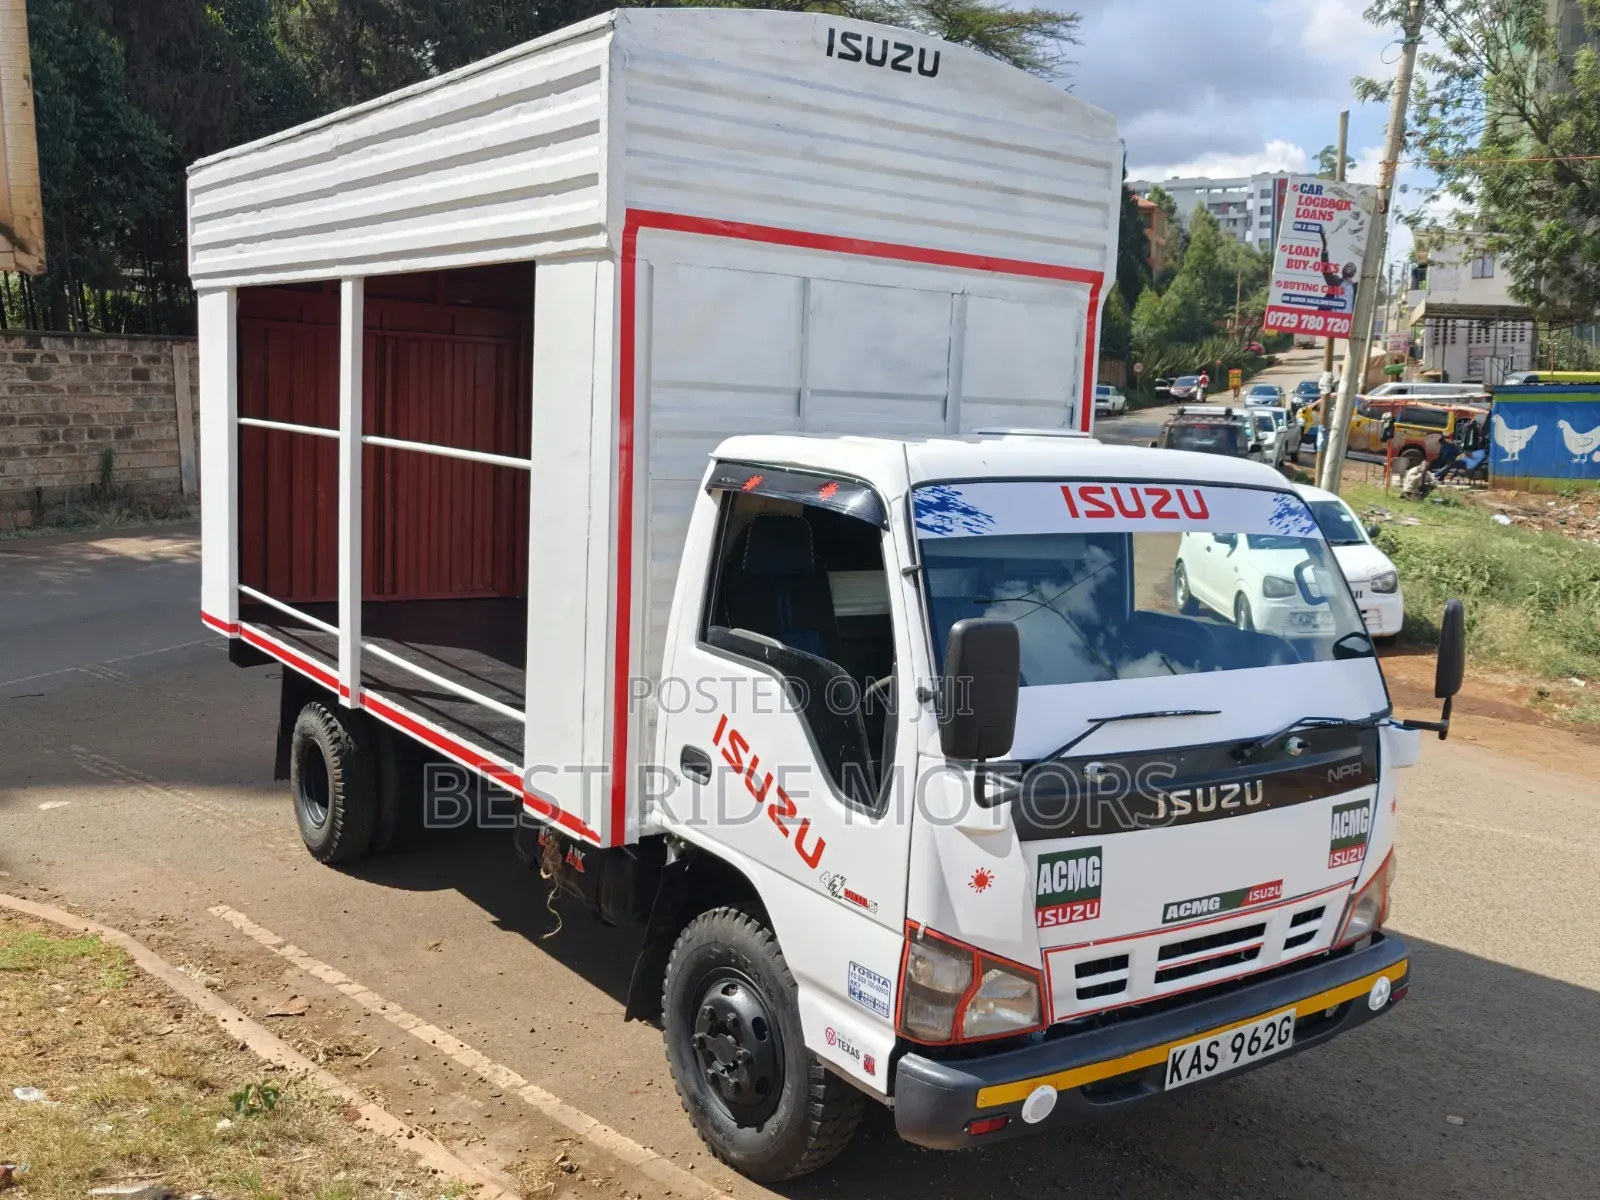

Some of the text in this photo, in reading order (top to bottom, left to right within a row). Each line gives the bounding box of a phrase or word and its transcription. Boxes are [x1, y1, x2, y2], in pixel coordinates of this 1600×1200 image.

[826, 27, 941, 78] ISUZU
[1300, 183, 1323, 196] CAR
[1295, 208, 1335, 222] LOANS
[1297, 195, 1352, 212] LOGBOOK
[1288, 244, 1321, 258] LOAN
[1283, 280, 1319, 293] BUYING
[1268, 311, 1350, 333] 0729 780 720
[1060, 485, 1210, 520] ISUZU
[1327, 762, 1362, 783] NPR
[713, 713, 826, 869] ISUZU
[1153, 779, 1263, 819] ISUZU
[1332, 807, 1370, 840] ACMG
[1329, 847, 1366, 868] ISUZU
[1037, 855, 1101, 896] ACMG
[1249, 884, 1283, 902] ISUZU
[1037, 902, 1099, 927] ISUZU
[1165, 896, 1221, 920] ACMG
[851, 963, 889, 989] TOSHA
[837, 1038, 860, 1060] TEXAS
[1169, 1015, 1292, 1085] KAS 962G
